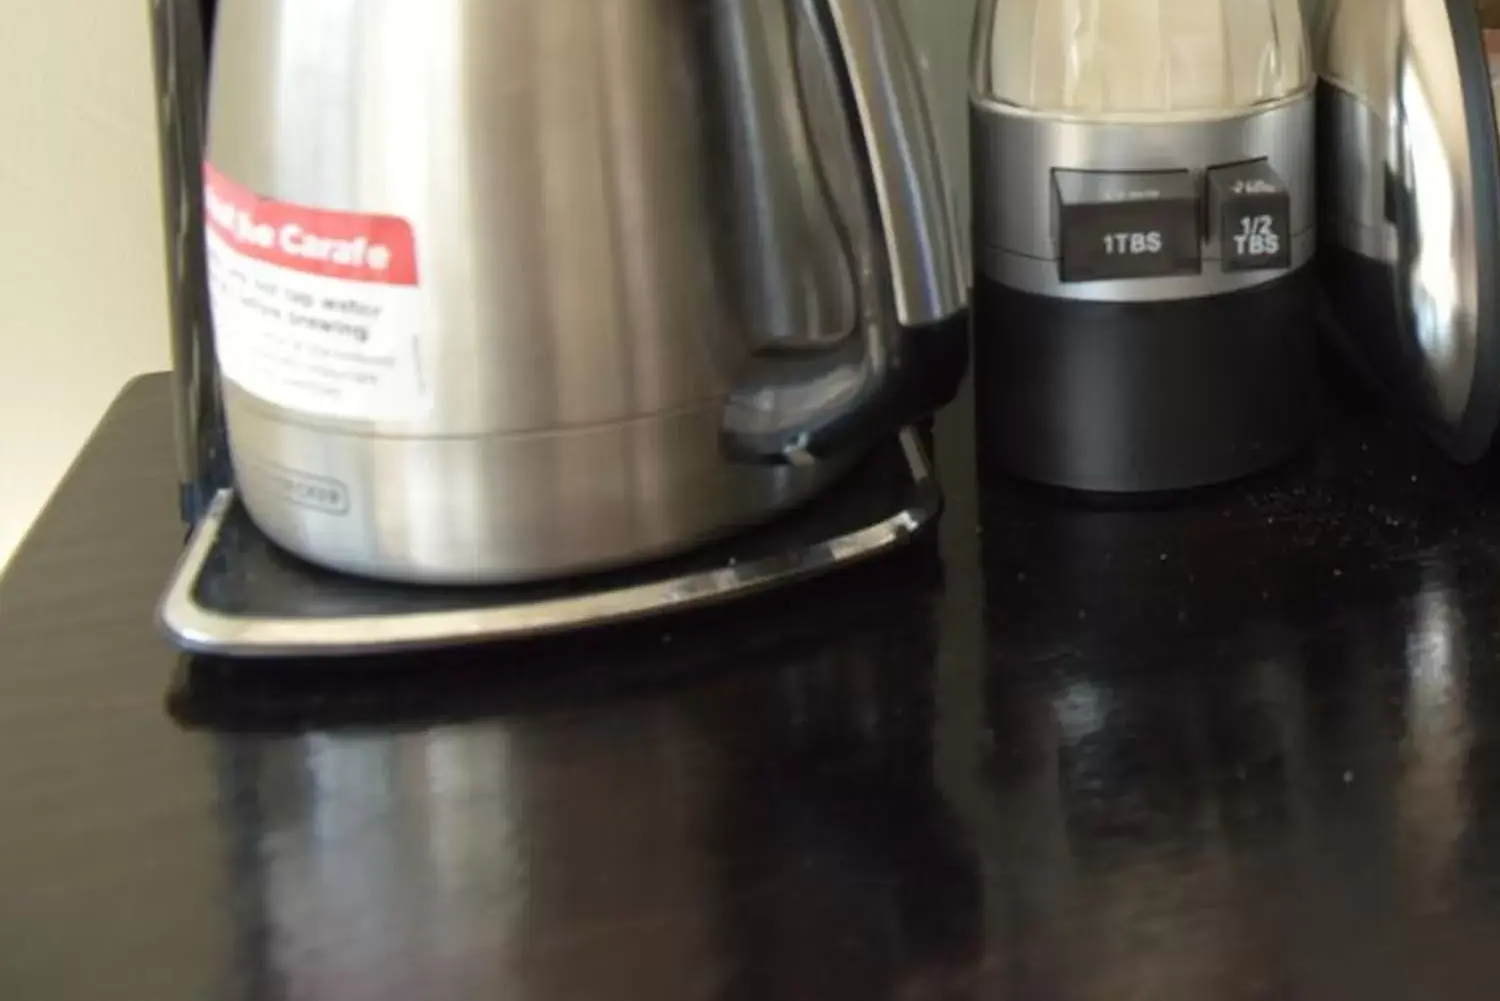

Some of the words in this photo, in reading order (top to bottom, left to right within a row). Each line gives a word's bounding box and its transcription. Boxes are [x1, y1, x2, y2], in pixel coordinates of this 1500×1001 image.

[1239, 214, 1273, 236] 1/2
[278, 223, 390, 271] Carafe
[1103, 230, 1162, 255] 1TBS
[1233, 233, 1280, 255] TBS
